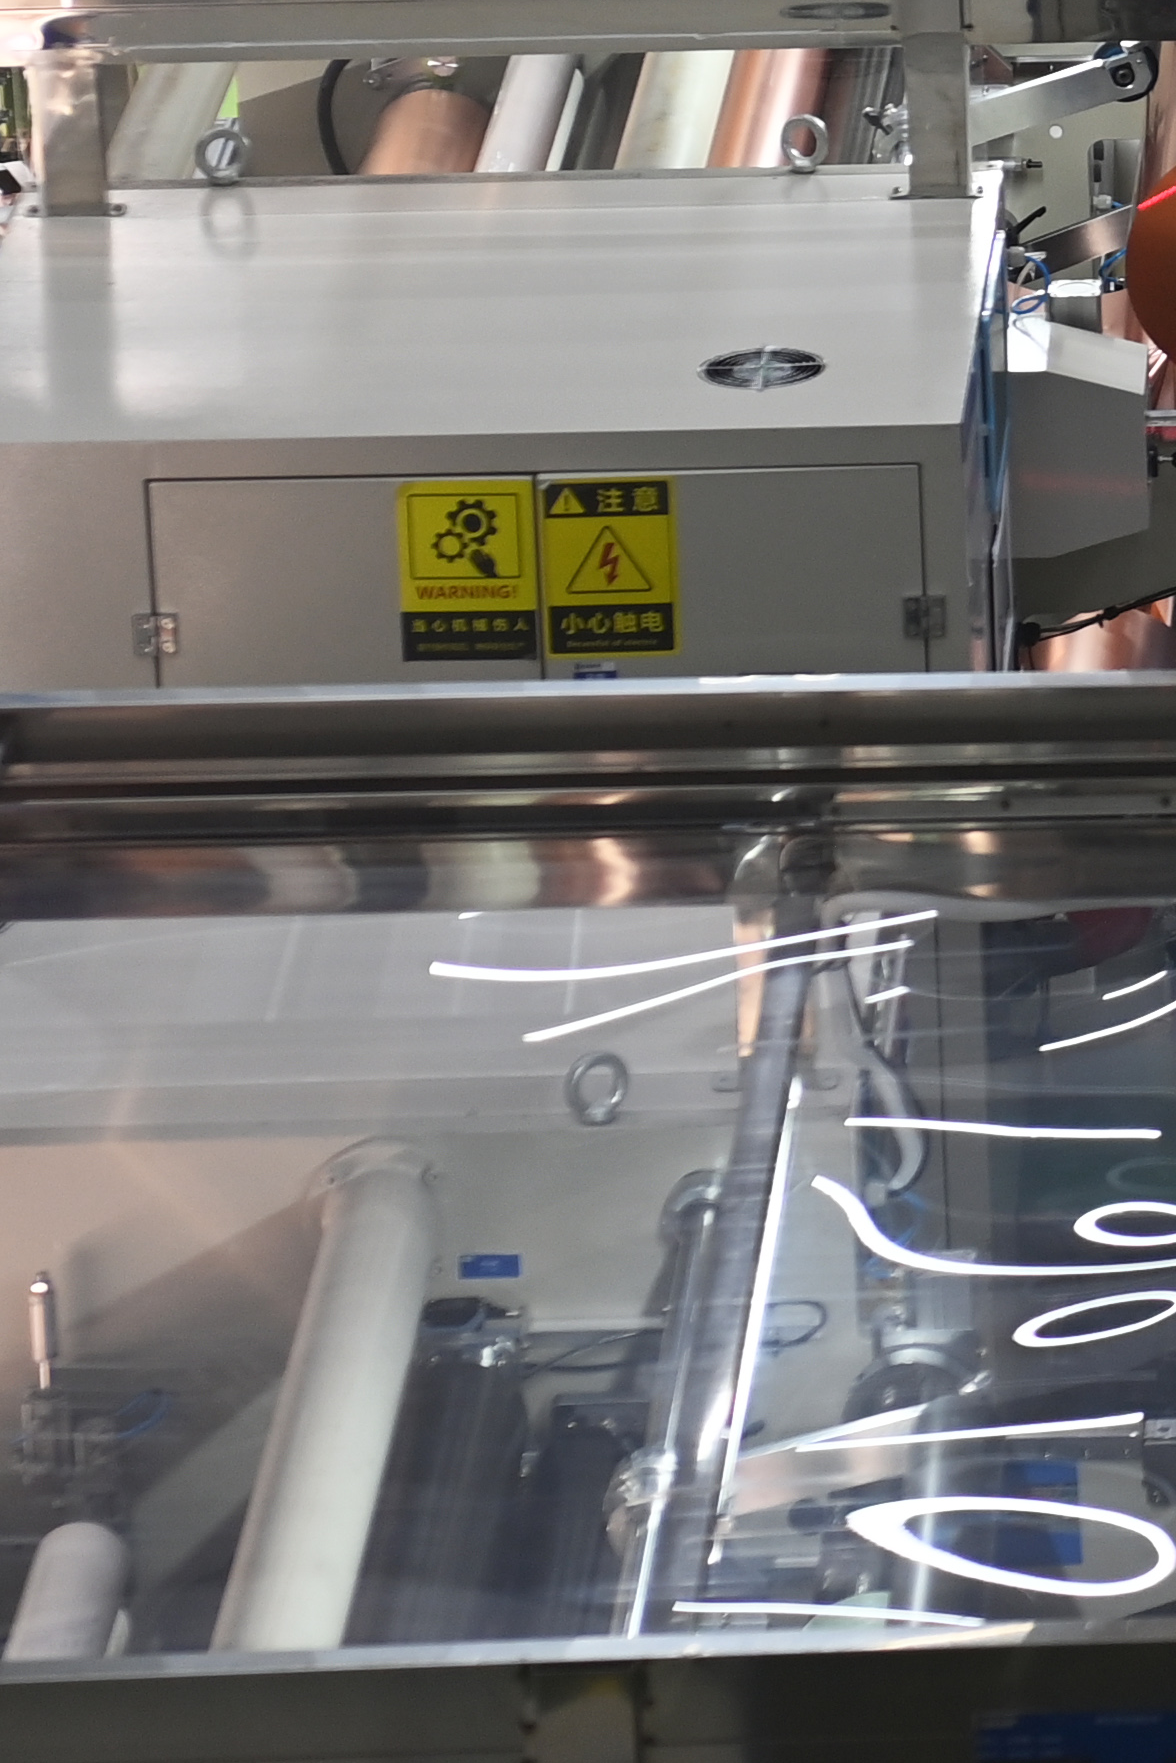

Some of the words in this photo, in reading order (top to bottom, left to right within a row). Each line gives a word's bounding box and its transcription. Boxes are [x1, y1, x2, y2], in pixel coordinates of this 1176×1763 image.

[596, 487, 659, 513] 注意
[415, 584, 517, 600] WARNING!
[560, 611, 665, 635] 小心触电
